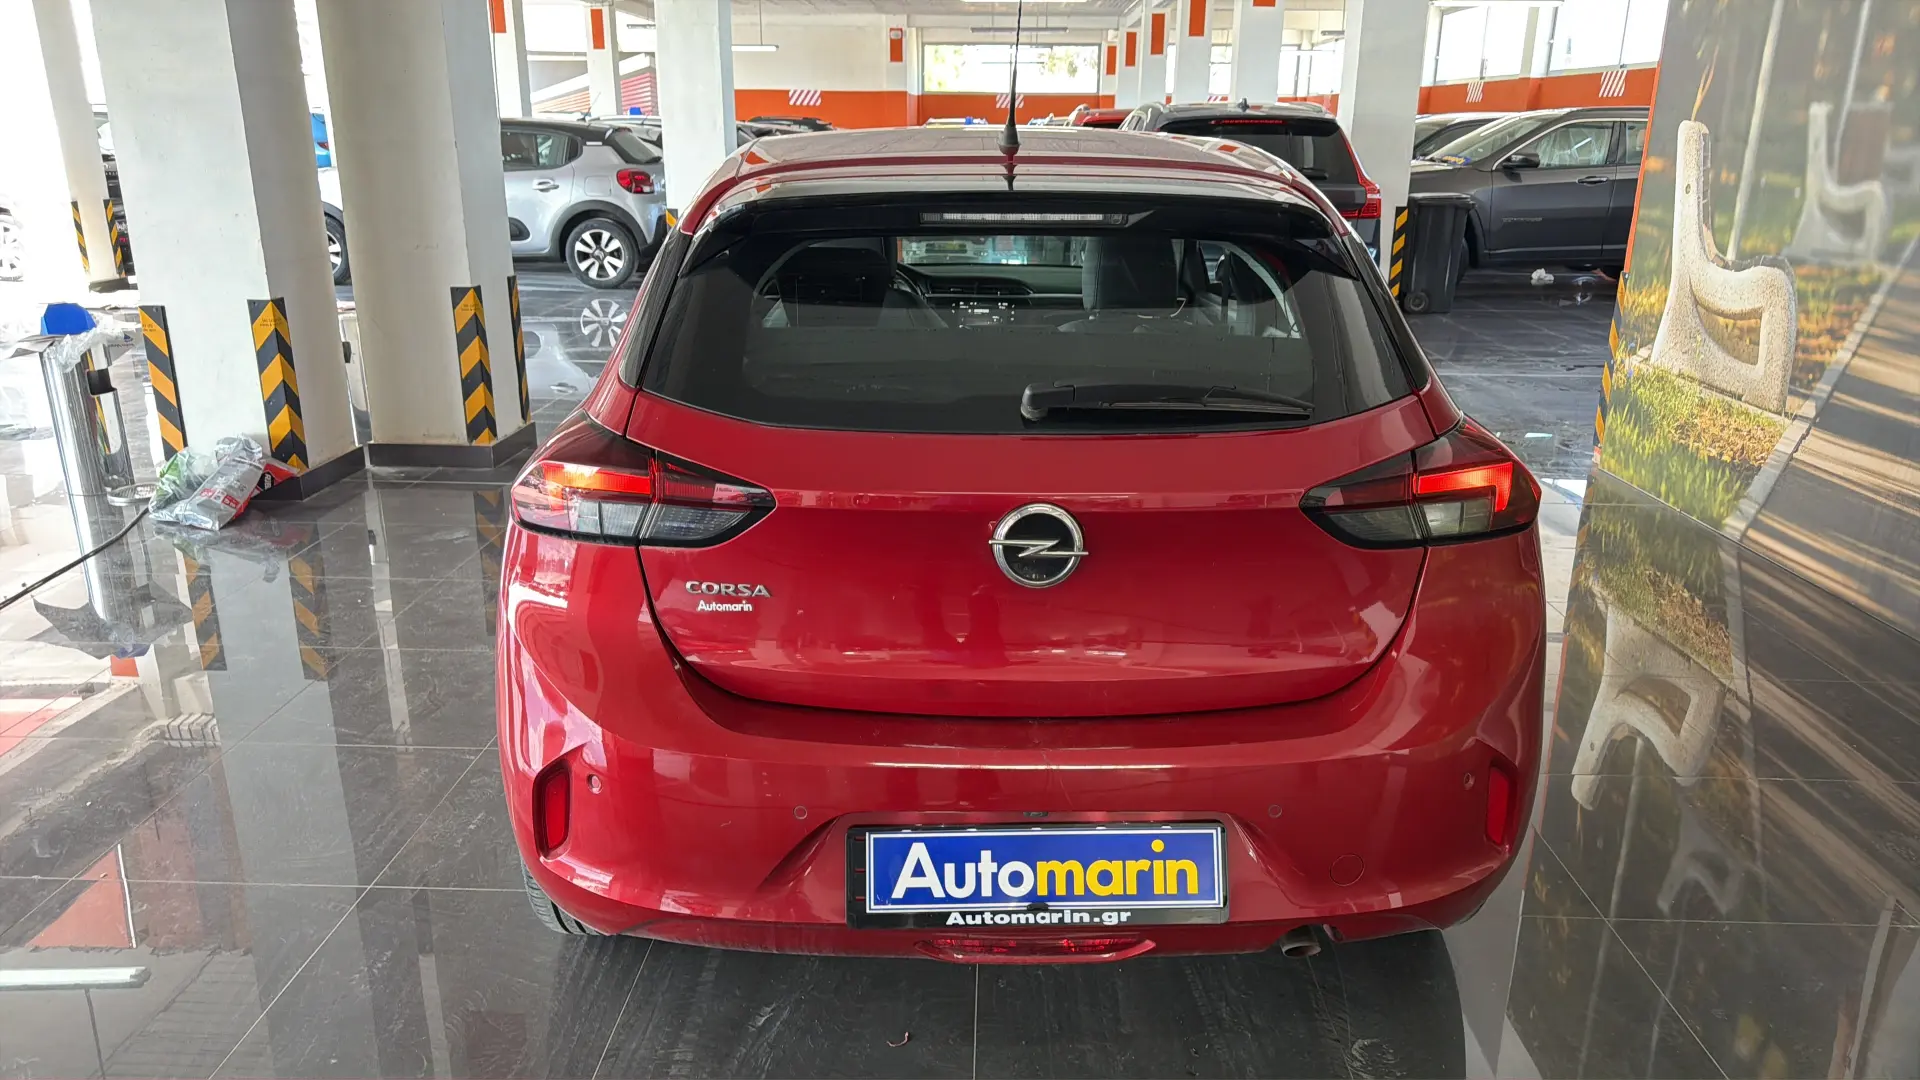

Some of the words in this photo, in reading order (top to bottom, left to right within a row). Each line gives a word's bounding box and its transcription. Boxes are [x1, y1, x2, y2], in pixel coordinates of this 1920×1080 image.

[685, 580, 772, 598] CORSA
[697, 599, 753, 612] Automarin
[891, 839, 1198, 899] Automarin
[945, 909, 1132, 926] Automarin.gr
